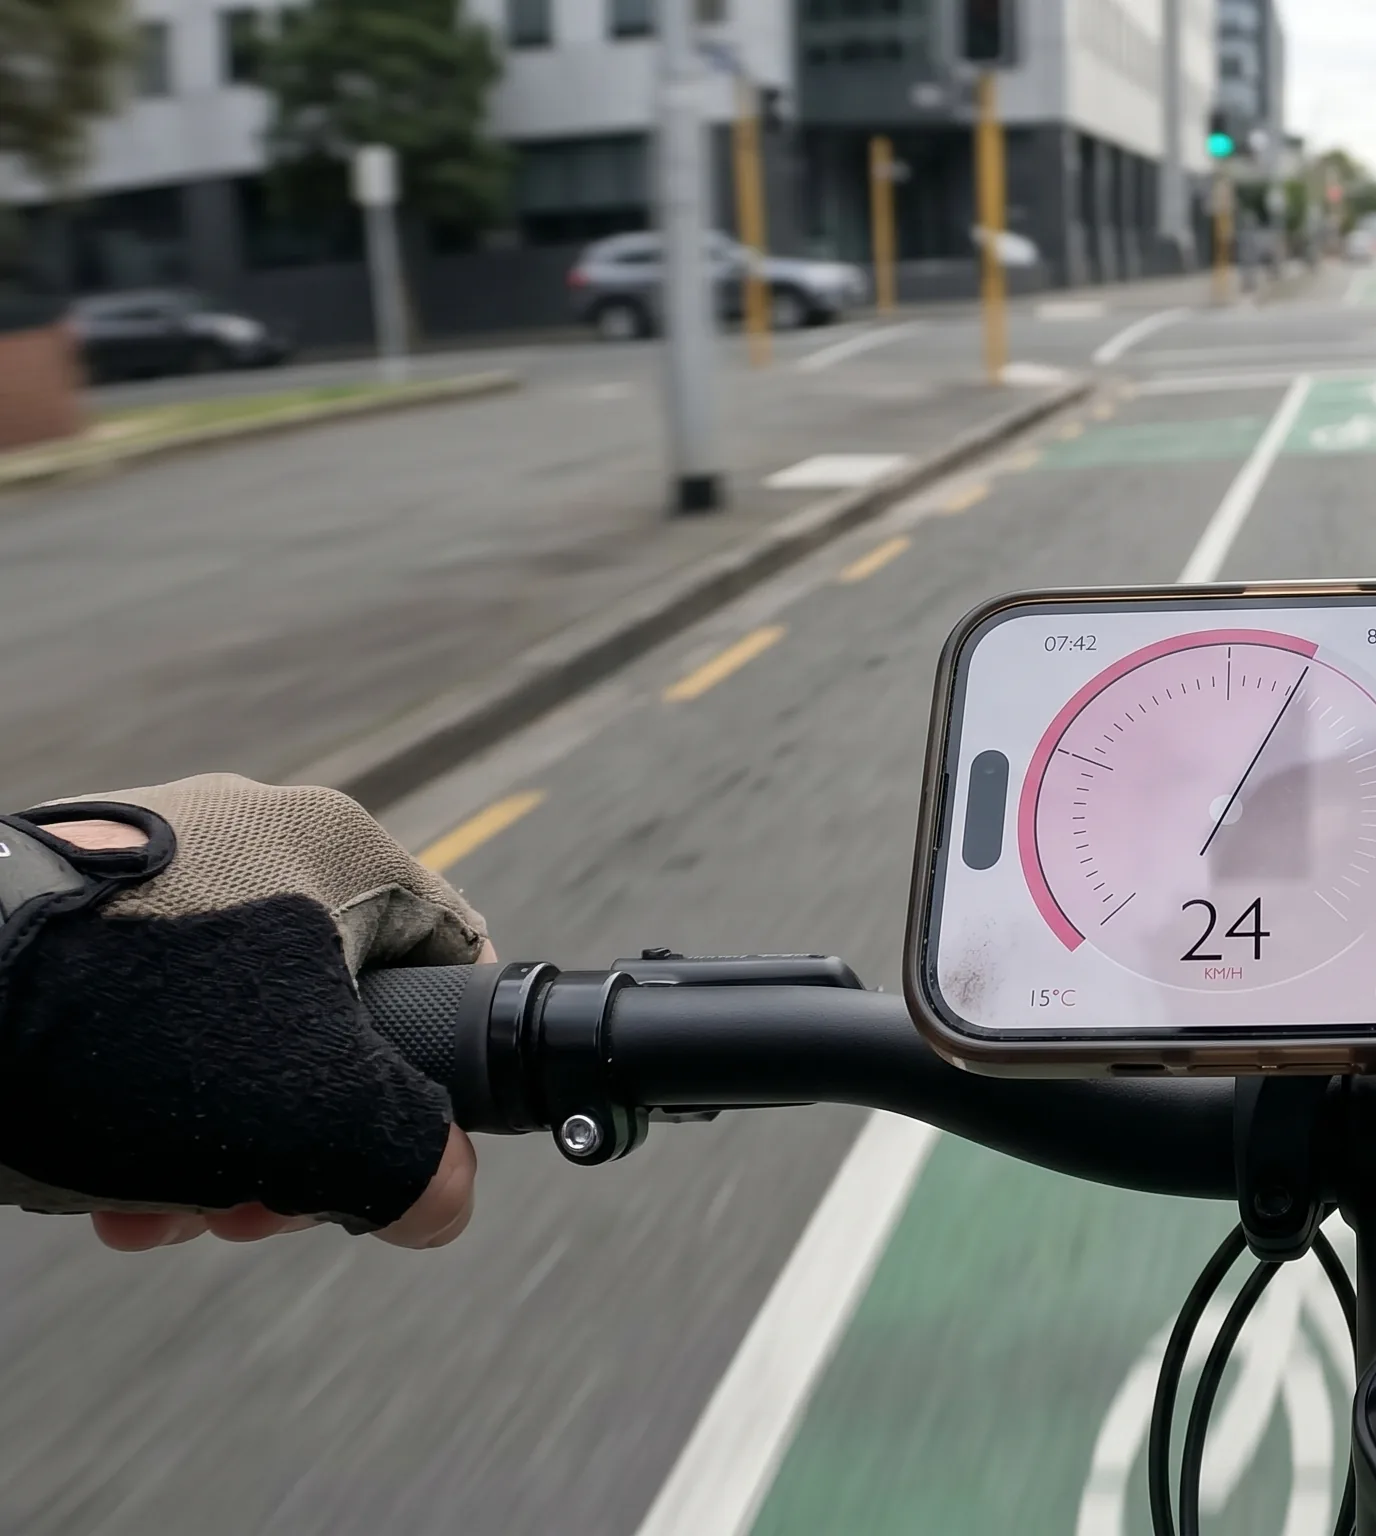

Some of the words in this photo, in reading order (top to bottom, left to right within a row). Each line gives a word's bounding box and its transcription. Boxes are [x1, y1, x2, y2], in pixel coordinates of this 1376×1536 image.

[1044, 634, 1097, 652] 07:42
[1179, 896, 1271, 962] 24
[1204, 966, 1243, 980] KM/H
[1030, 988, 1076, 1007] 15°C
